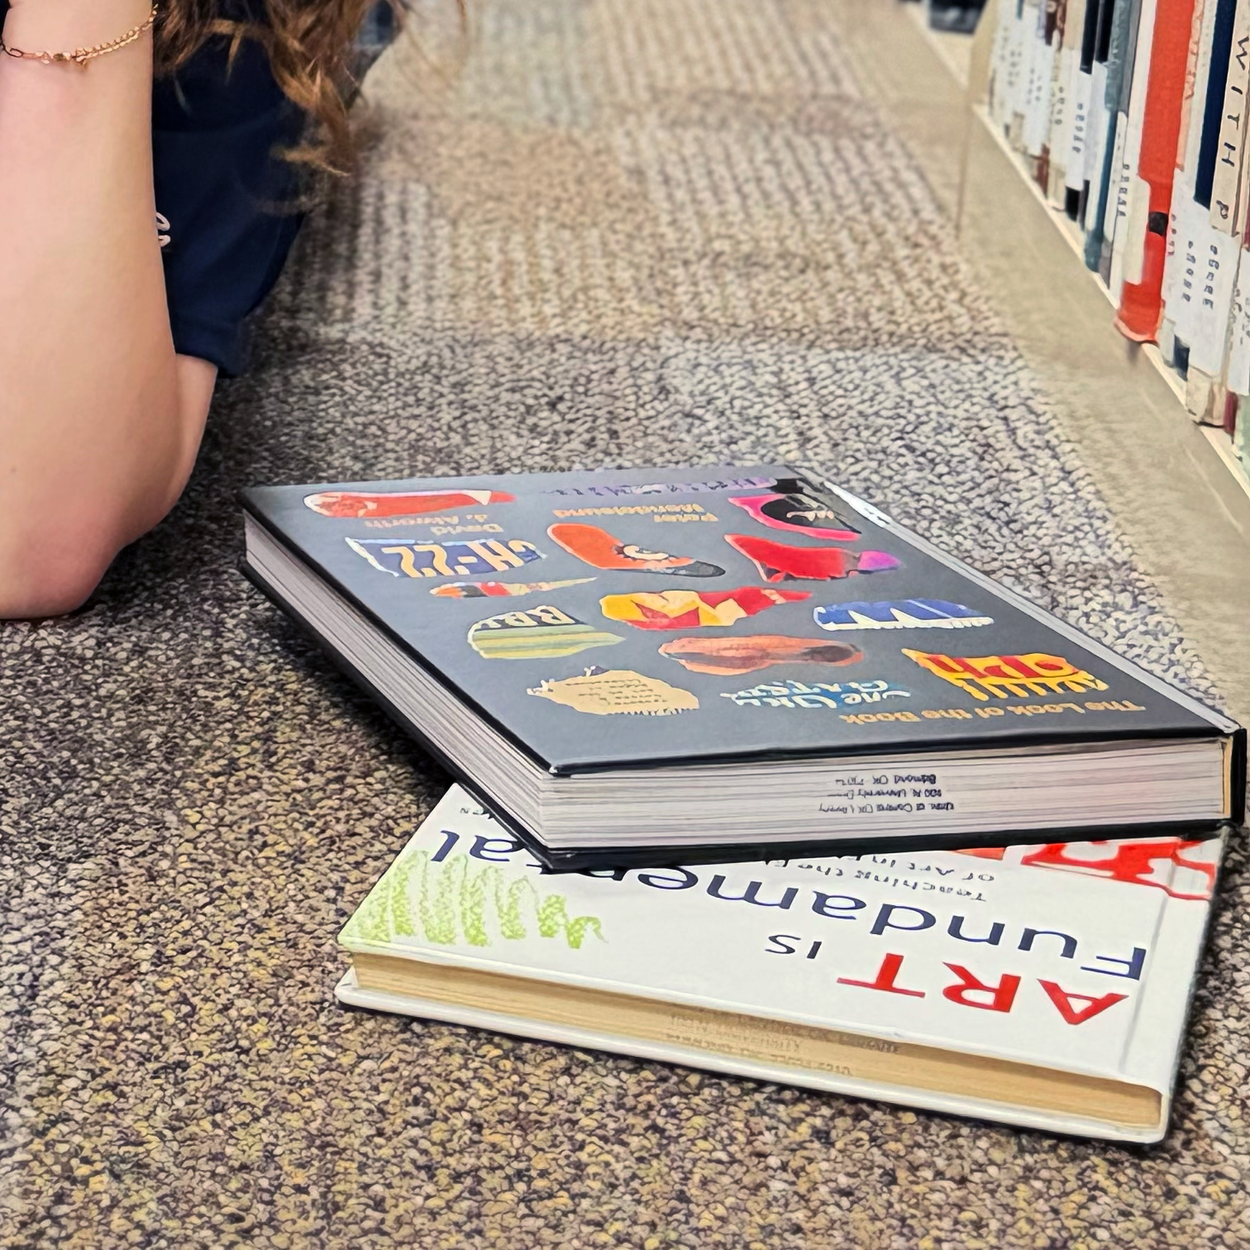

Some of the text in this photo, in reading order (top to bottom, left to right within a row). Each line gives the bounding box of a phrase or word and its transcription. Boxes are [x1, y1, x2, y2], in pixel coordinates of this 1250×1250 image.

[839, 700, 1146, 726] The Look of the Book
[765, 933, 822, 960] IS
[836, 952, 1129, 1026] ART
